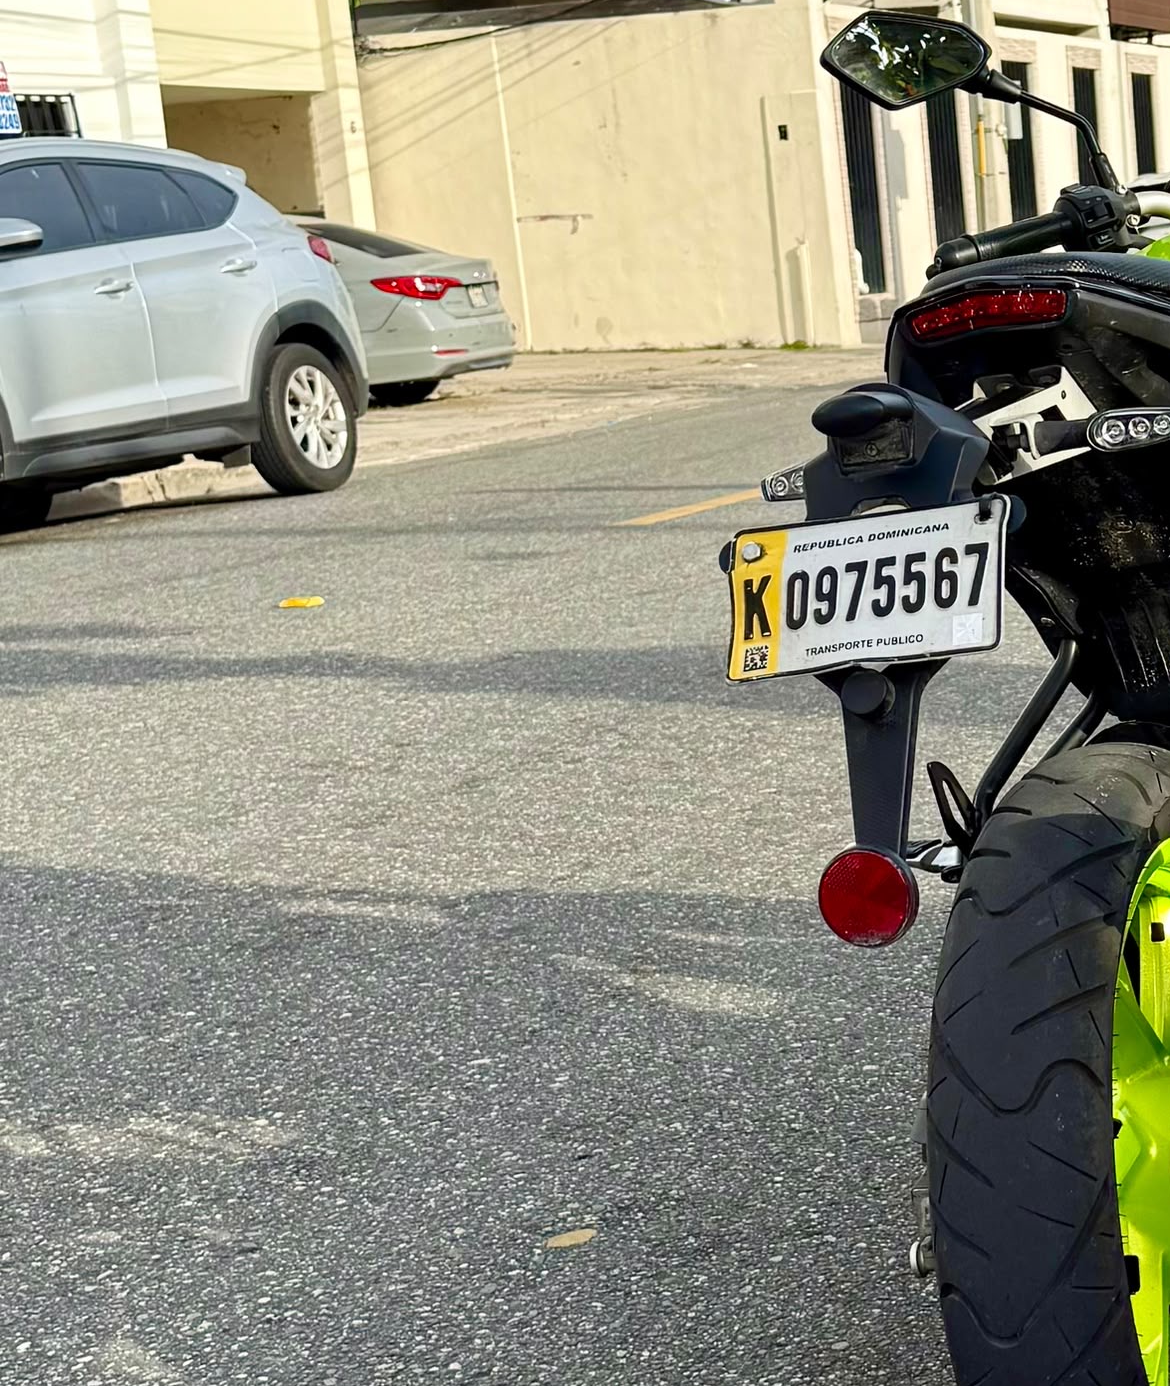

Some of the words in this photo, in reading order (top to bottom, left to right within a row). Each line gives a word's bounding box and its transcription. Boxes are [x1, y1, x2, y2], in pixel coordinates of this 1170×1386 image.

[793, 535, 864, 554] REPUBLICA
[868, 523, 950, 542] DOMINICANA
[786, 542, 990, 630] 0975567
[805, 638, 873, 657] TRANSPORTE
[876, 633, 924, 647] PUBLICO
